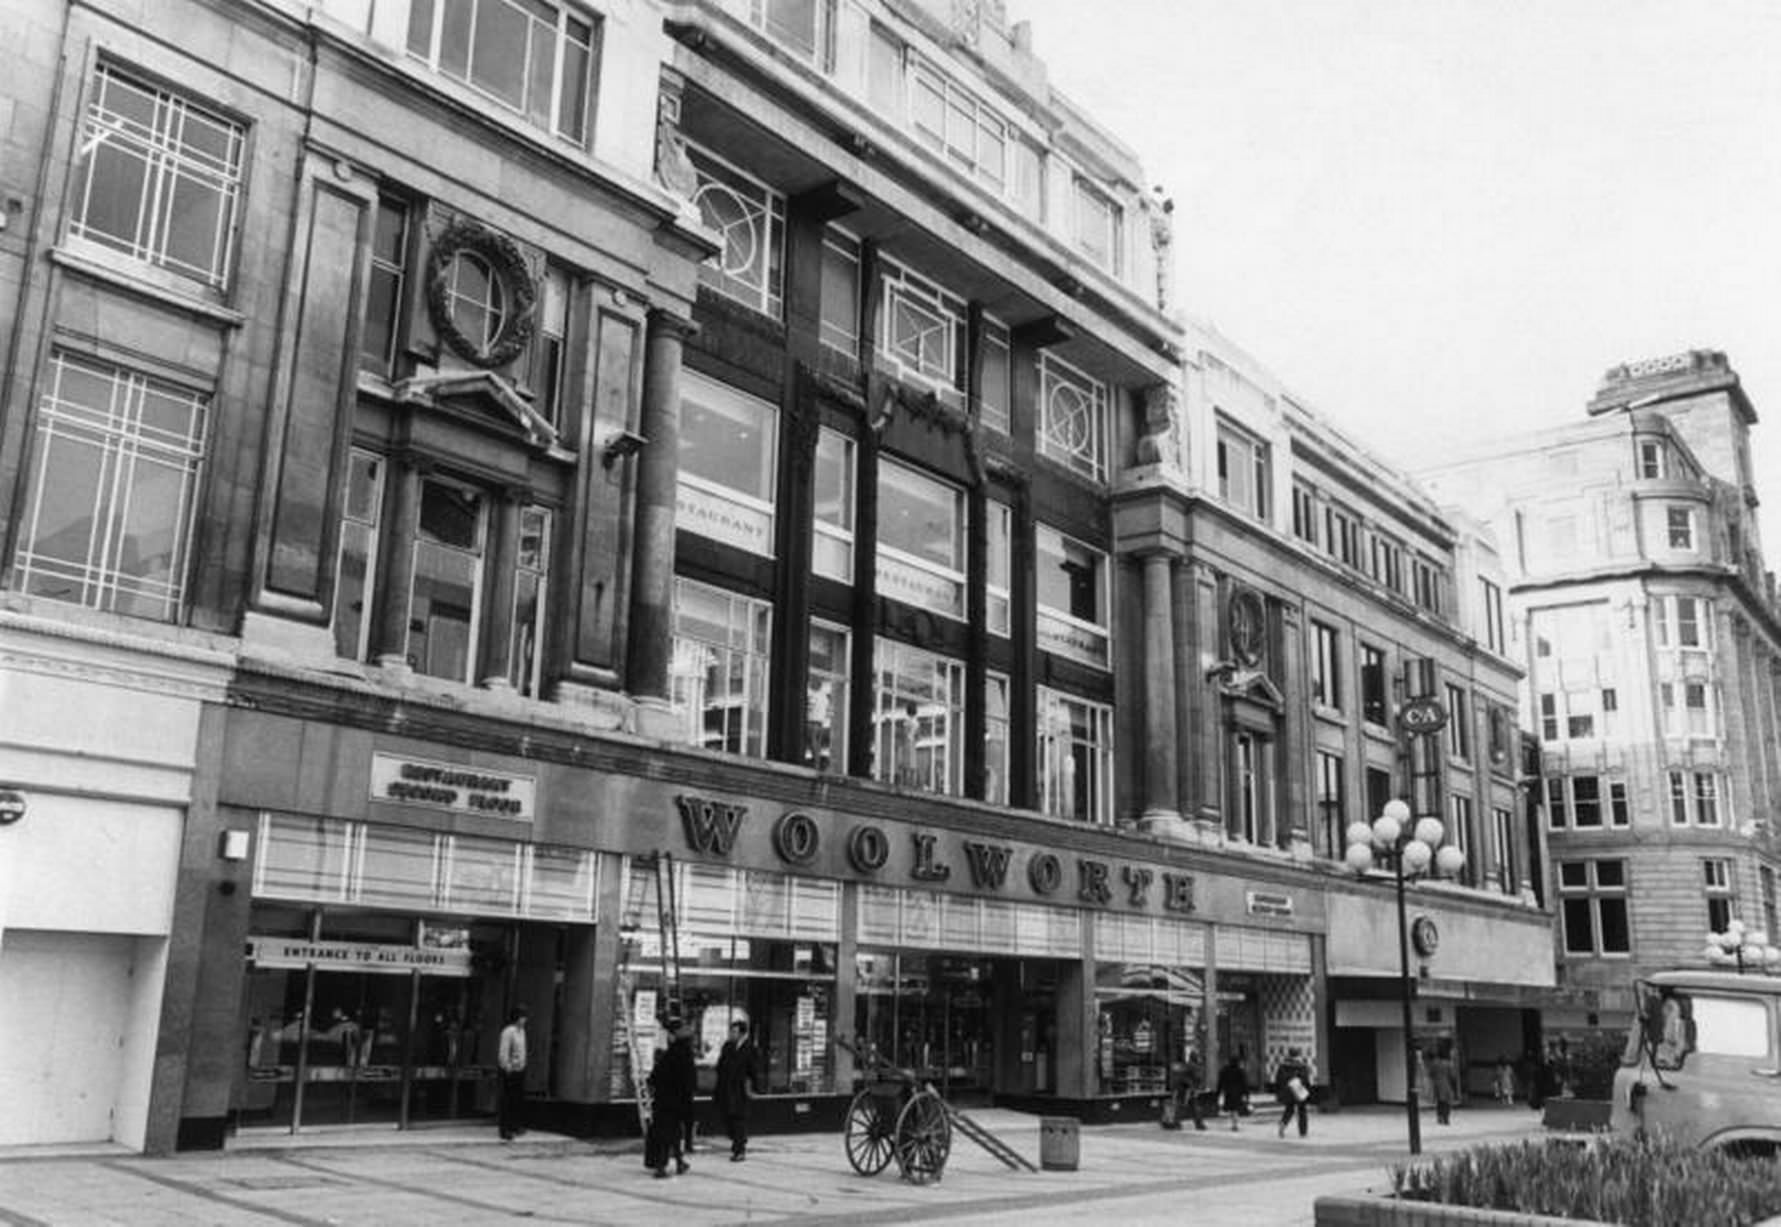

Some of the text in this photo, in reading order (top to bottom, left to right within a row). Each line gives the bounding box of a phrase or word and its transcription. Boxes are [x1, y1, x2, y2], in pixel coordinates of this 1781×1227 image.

[675, 794, 1198, 913] WOOLWORTH
[283, 947, 445, 964] ENTRANCE TO ALL FLOORS
